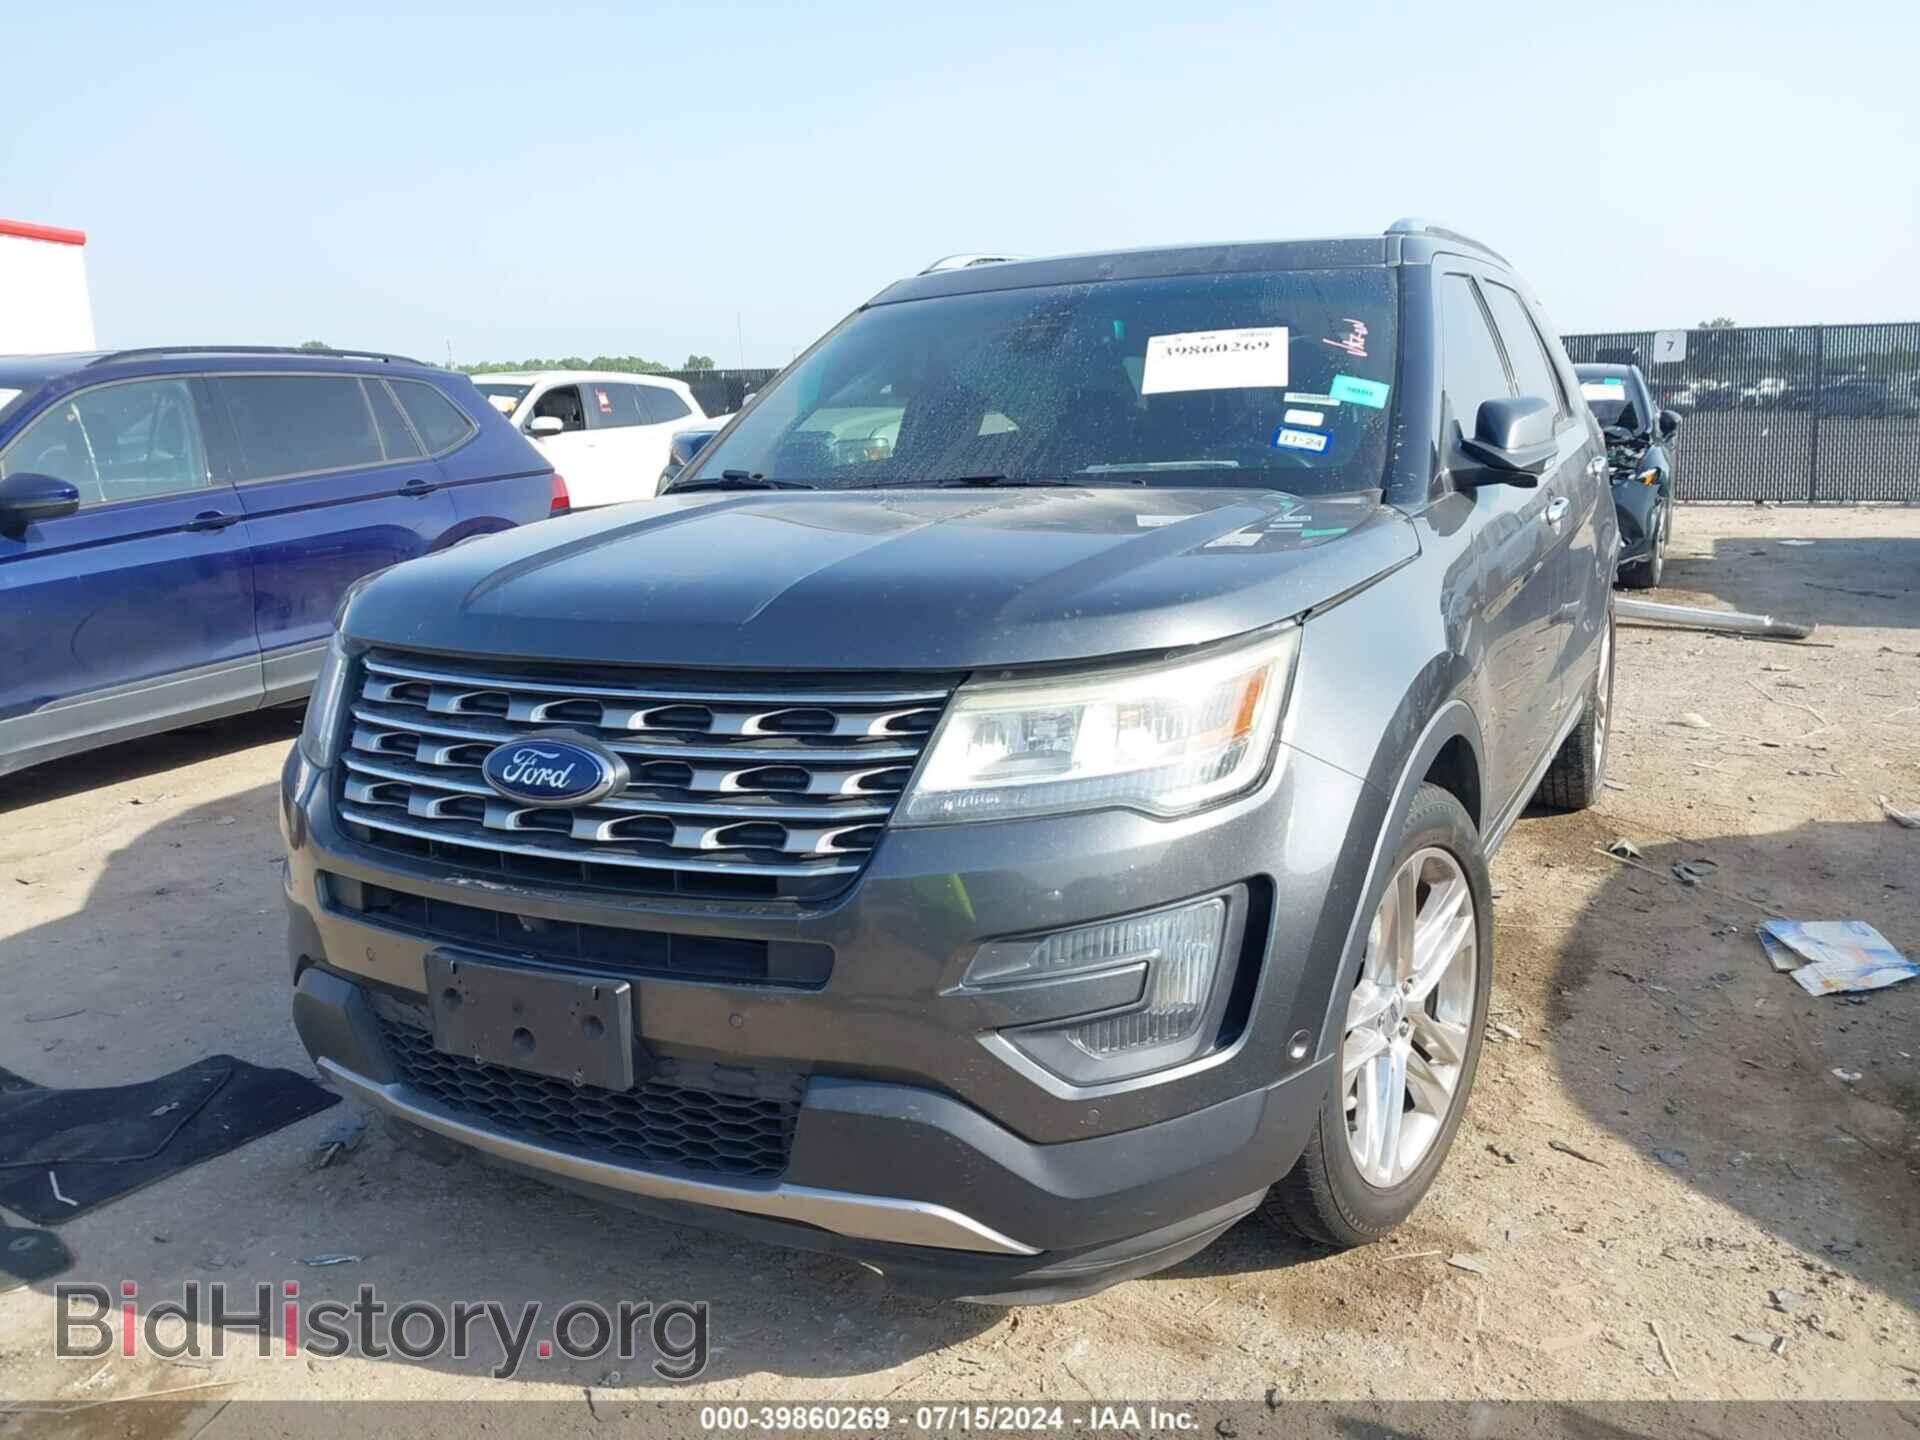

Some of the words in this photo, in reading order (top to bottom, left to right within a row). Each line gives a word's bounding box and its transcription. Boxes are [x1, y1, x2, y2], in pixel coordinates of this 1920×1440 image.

[1666, 341, 1675, 352] 7
[1283, 433, 1323, 448] 11-24
[502, 748, 577, 789] Ford
